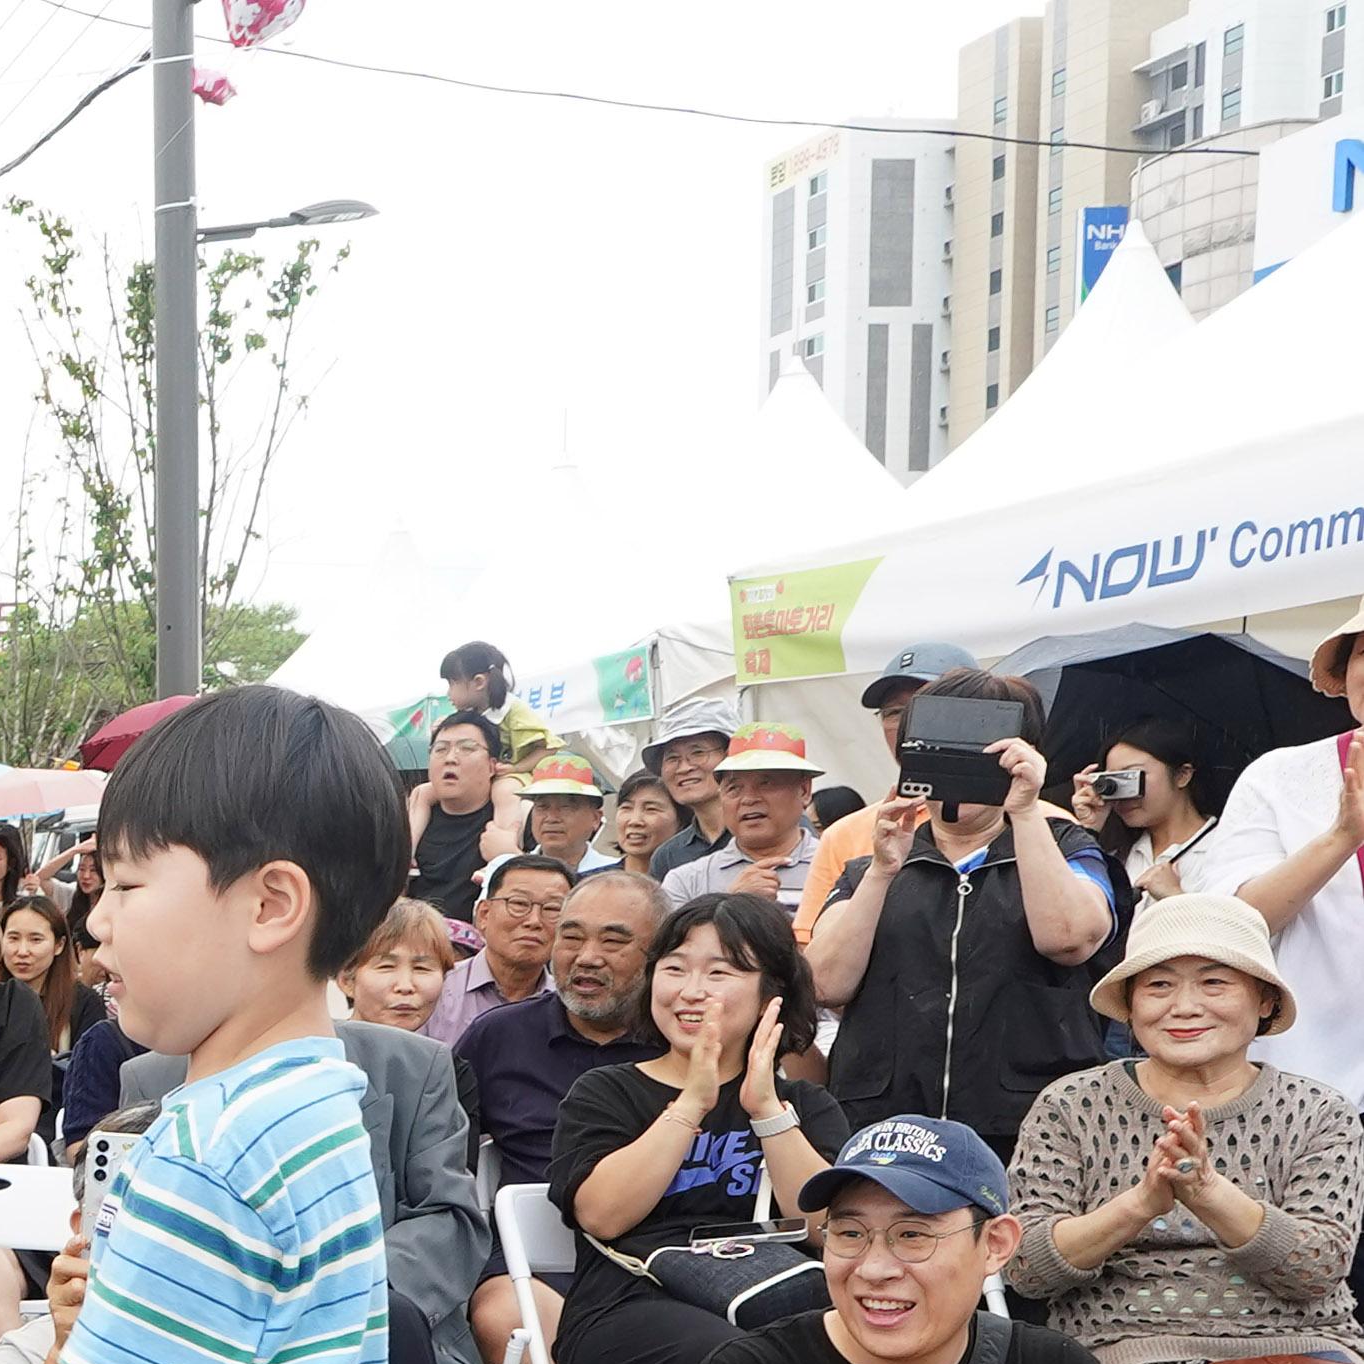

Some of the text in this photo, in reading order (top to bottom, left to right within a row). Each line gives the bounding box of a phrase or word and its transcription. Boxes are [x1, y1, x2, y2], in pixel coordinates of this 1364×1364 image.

[1087, 224, 1125, 240] NH
[895, 1121, 940, 1144] BRITAIN
[874, 1132, 947, 1163] CLASSICS
